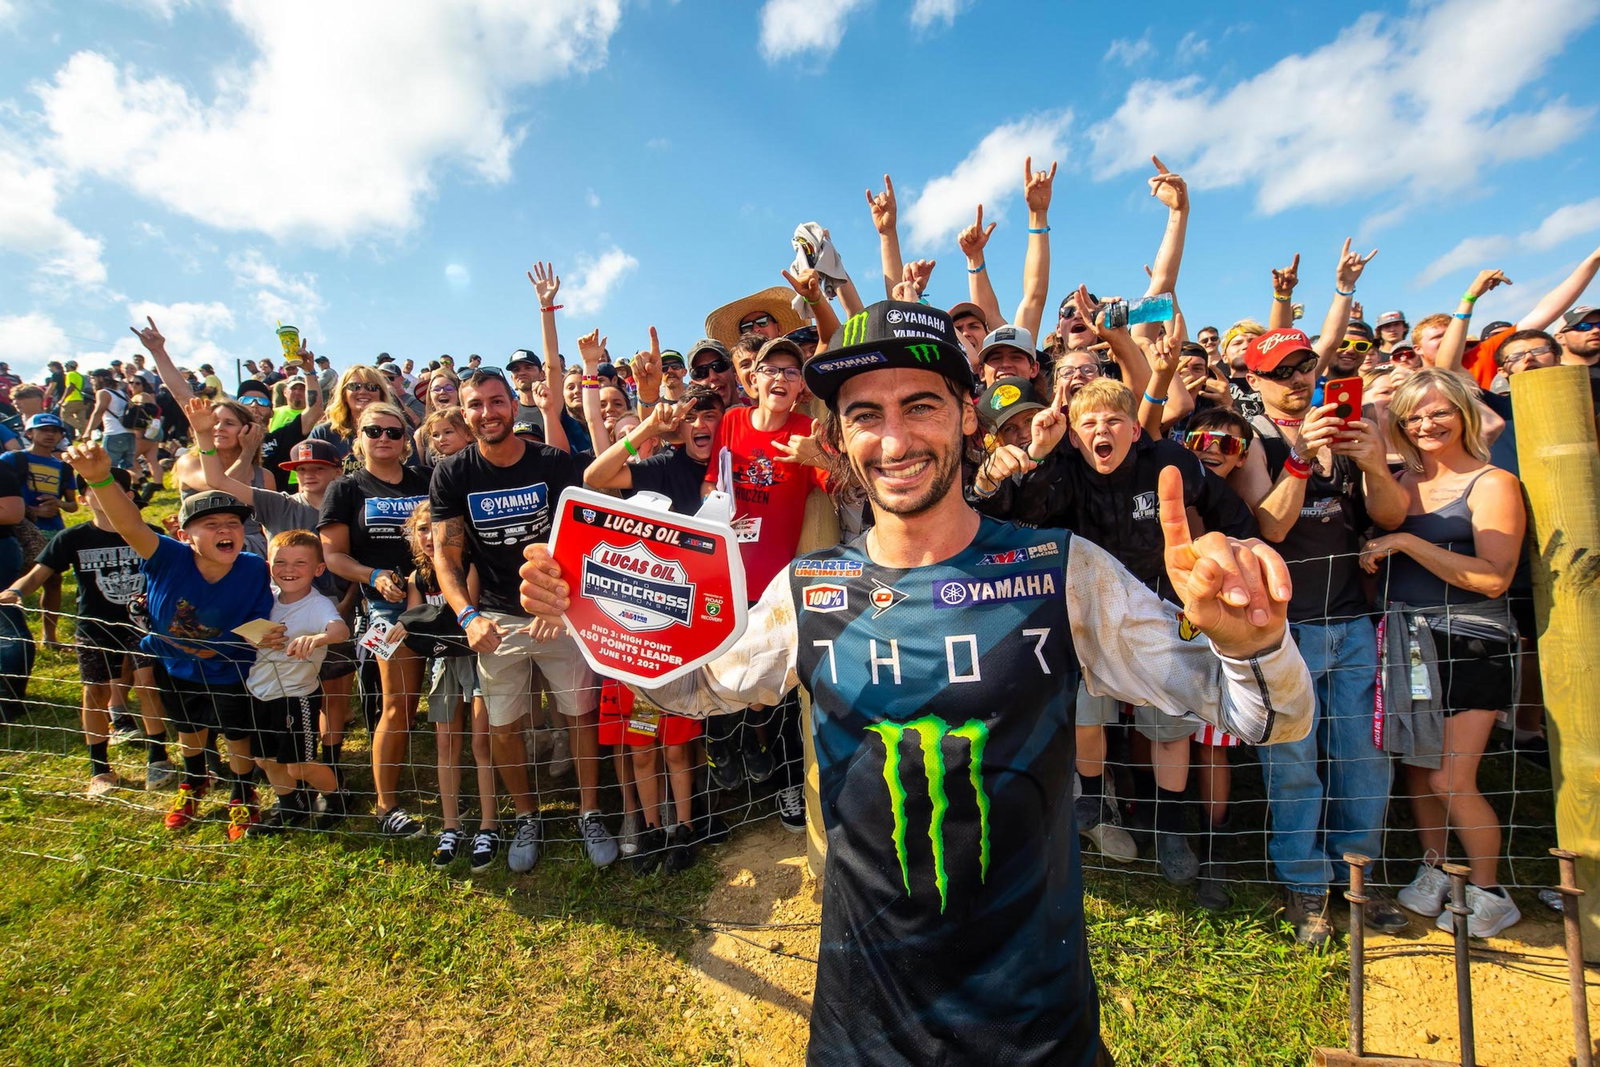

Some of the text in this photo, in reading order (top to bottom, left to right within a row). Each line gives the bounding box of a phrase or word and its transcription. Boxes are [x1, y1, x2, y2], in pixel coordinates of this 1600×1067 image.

[903, 311, 946, 334] YAMAHA
[1257, 333, 1301, 354] Bud
[832, 355, 879, 368] YAMAHA
[487, 504, 538, 515] RACING
[494, 491, 540, 510] YAMAHA
[603, 514, 680, 545] LUCAS OIL
[976, 541, 1058, 565] AMA PRO
[1030, 549, 1059, 559] RACING
[600, 550, 675, 581] LUCAS OIL
[795, 569, 862, 577] UNLIMITED
[797, 560, 863, 570] PARTS
[586, 572, 688, 609] MOTOCROSS
[622, 577, 650, 588] PRO
[968, 573, 1056, 601] YAMAHA
[586, 584, 687, 614] CHAMPIONSHIP
[704, 596, 724, 605] ROAD
[809, 590, 842, 606] 100%
[709, 606, 717, 615] 2
[580, 629, 683, 665] 450 POINTS LEADER
[591, 624, 672, 653] RND 3: HIGH POINT
[599, 647, 660, 670] JUNE 19, 2021
[813, 627, 1051, 685] THOR
